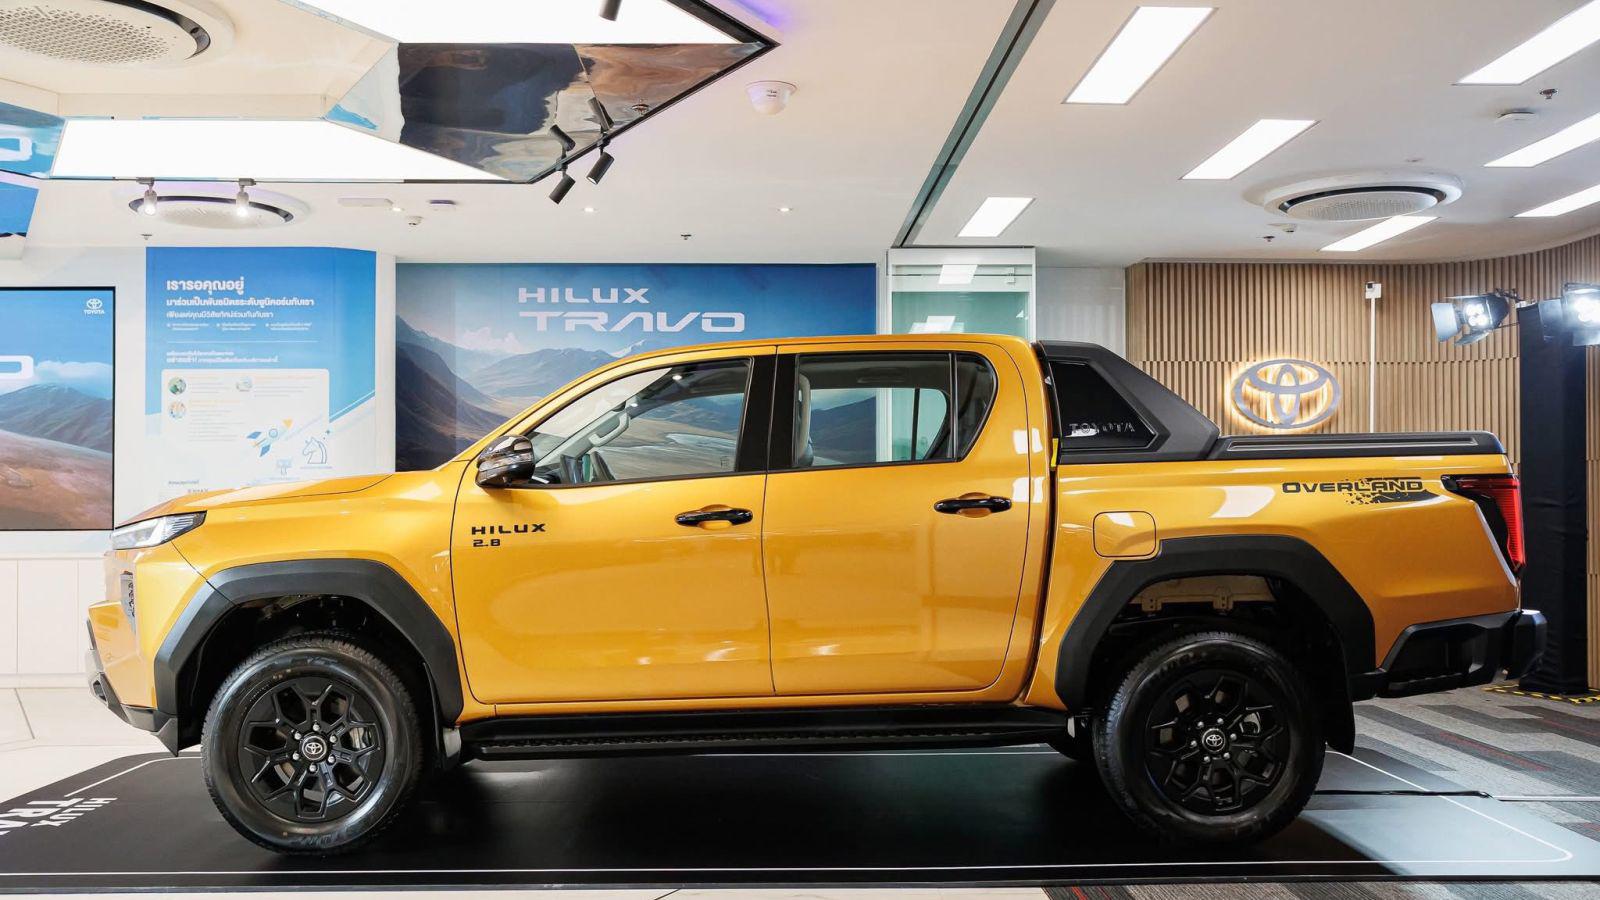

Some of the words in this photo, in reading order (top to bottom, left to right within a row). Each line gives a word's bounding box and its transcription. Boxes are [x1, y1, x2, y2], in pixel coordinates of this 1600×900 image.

[166, 276, 244, 295] เรารอคุณอยู่
[518, 287, 650, 303] HILUX
[518, 311, 745, 332] TRAVO
[1282, 481, 1423, 493] OVERLAND
[471, 523, 546, 534] HILUX
[473, 538, 501, 547] 2.8
[30, 797, 118, 827] HILUX
